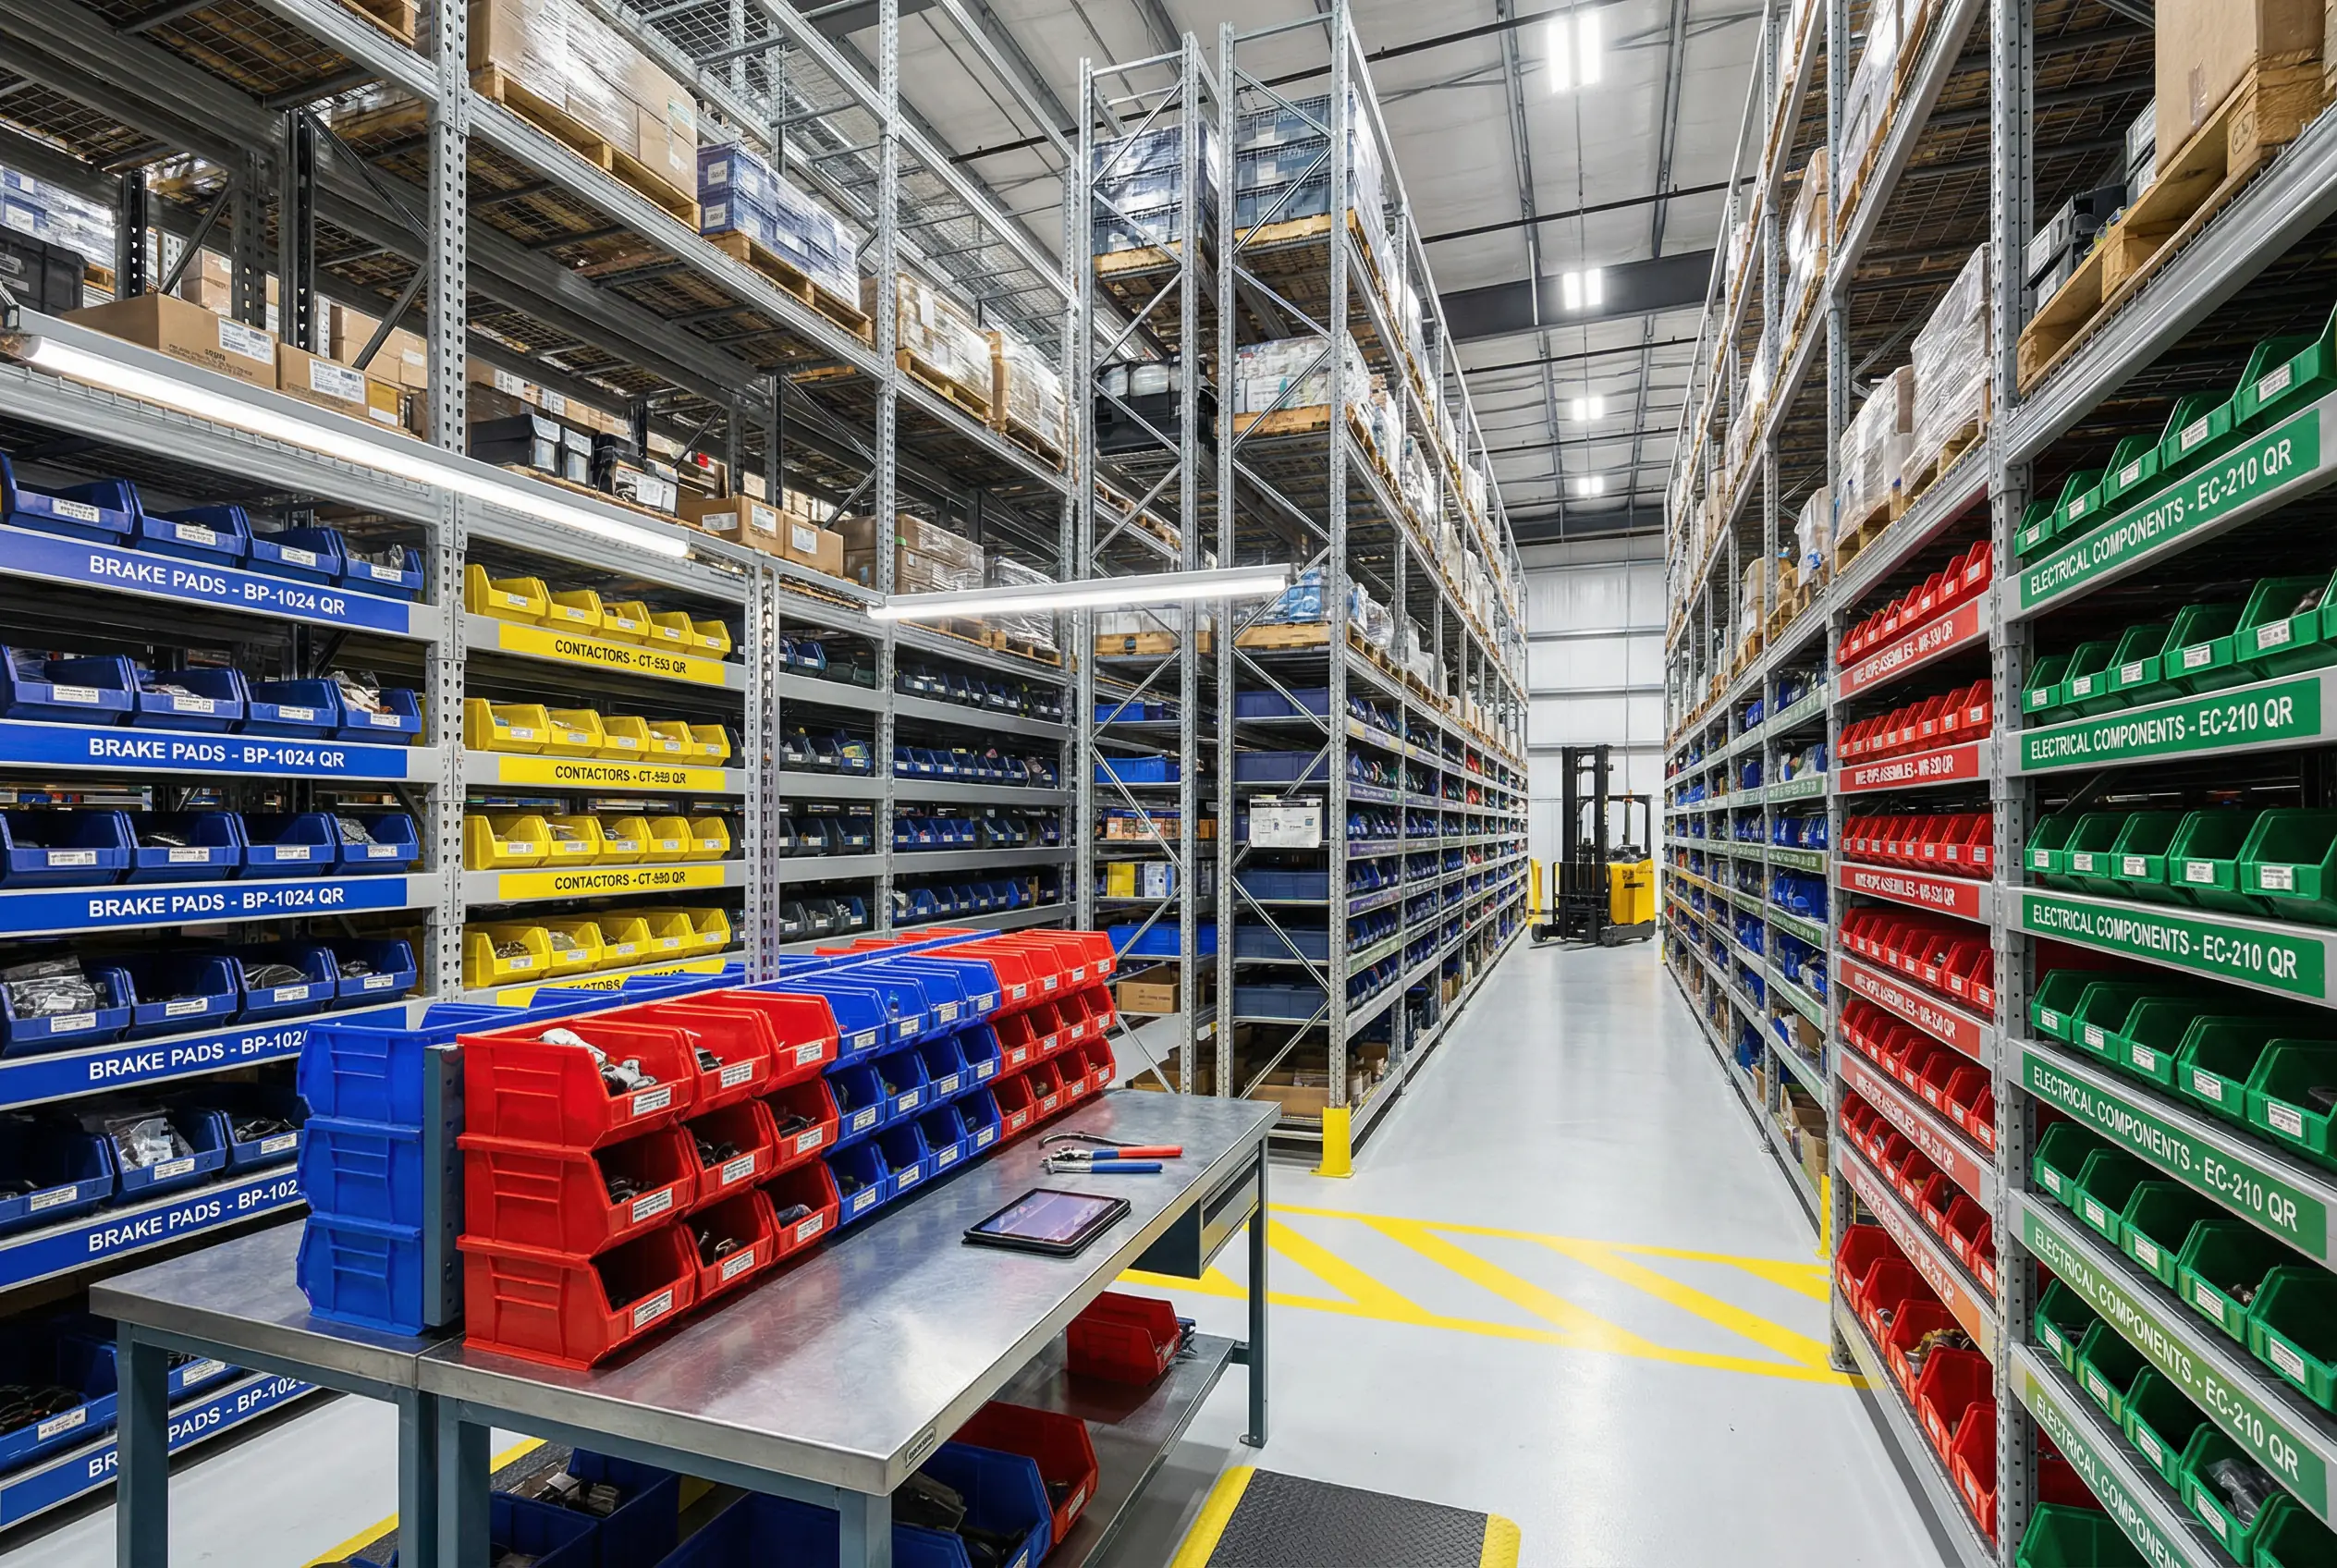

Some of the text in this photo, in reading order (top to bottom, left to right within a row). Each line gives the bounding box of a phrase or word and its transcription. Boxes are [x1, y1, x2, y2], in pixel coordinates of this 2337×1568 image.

[2031, 547, 2091, 596] ELECTRICAL
[2092, 496, 2184, 564] COMPONENTS
[2197, 457, 2257, 511] EC-210
[2262, 438, 2293, 476] QR
[90, 555, 166, 585] BRAKE
[173, 570, 226, 595] PADS
[244, 582, 315, 610] BP-1024
[320, 596, 346, 616] QR
[555, 639, 630, 664] CONTACTORS
[89, 738, 166, 760] BRAKE
[172, 742, 226, 762] PADS
[243, 746, 315, 766] BP-1024
[319, 751, 345, 768] QR
[2031, 732, 2091, 760] ELECTRICAL
[2093, 715, 2185, 752] COMPONENTS
[2199, 702, 2258, 737] EC-210
[2263, 696, 2294, 728] QR
[555, 766, 630, 782] CONTACTORS
[672, 772, 686, 784] QR
[89, 897, 165, 918] BRAKE
[172, 893, 226, 913] PADS
[242, 888, 315, 909] BP-1024
[318, 887, 345, 904] QR
[555, 874, 630, 890] CONTACTORS
[672, 871, 686, 884] QR
[2033, 904, 2095, 935] ELECTRICAL
[2096, 915, 2190, 955] COMPONENTS
[2203, 935, 2262, 971] EC-210
[2267, 946, 2297, 979] QR
[90, 1051, 165, 1081] BRAKE
[171, 1042, 225, 1067] PADS
[2034, 1065, 2096, 1118] ELECTRICAL
[2097, 1100, 2190, 1170] COMPONENTS
[2204, 1156, 2262, 1212] EC-210
[2268, 1192, 2298, 1232] QR
[89, 1216, 163, 1252] BRAKE
[169, 1200, 221, 1230] PADS
[238, 1179, 300, 1209] BP-102
[2035, 1226, 2098, 1299] ELECTRICAL
[2098, 1283, 2192, 1384] COMPONENTS
[2205, 1375, 2264, 1449] EC-210
[2269, 1433, 2299, 1482] QR
[168, 1406, 221, 1443] PADS
[238, 1377, 306, 1413] BP-102
[2036, 1393, 2098, 1488] ELECTRICAL
